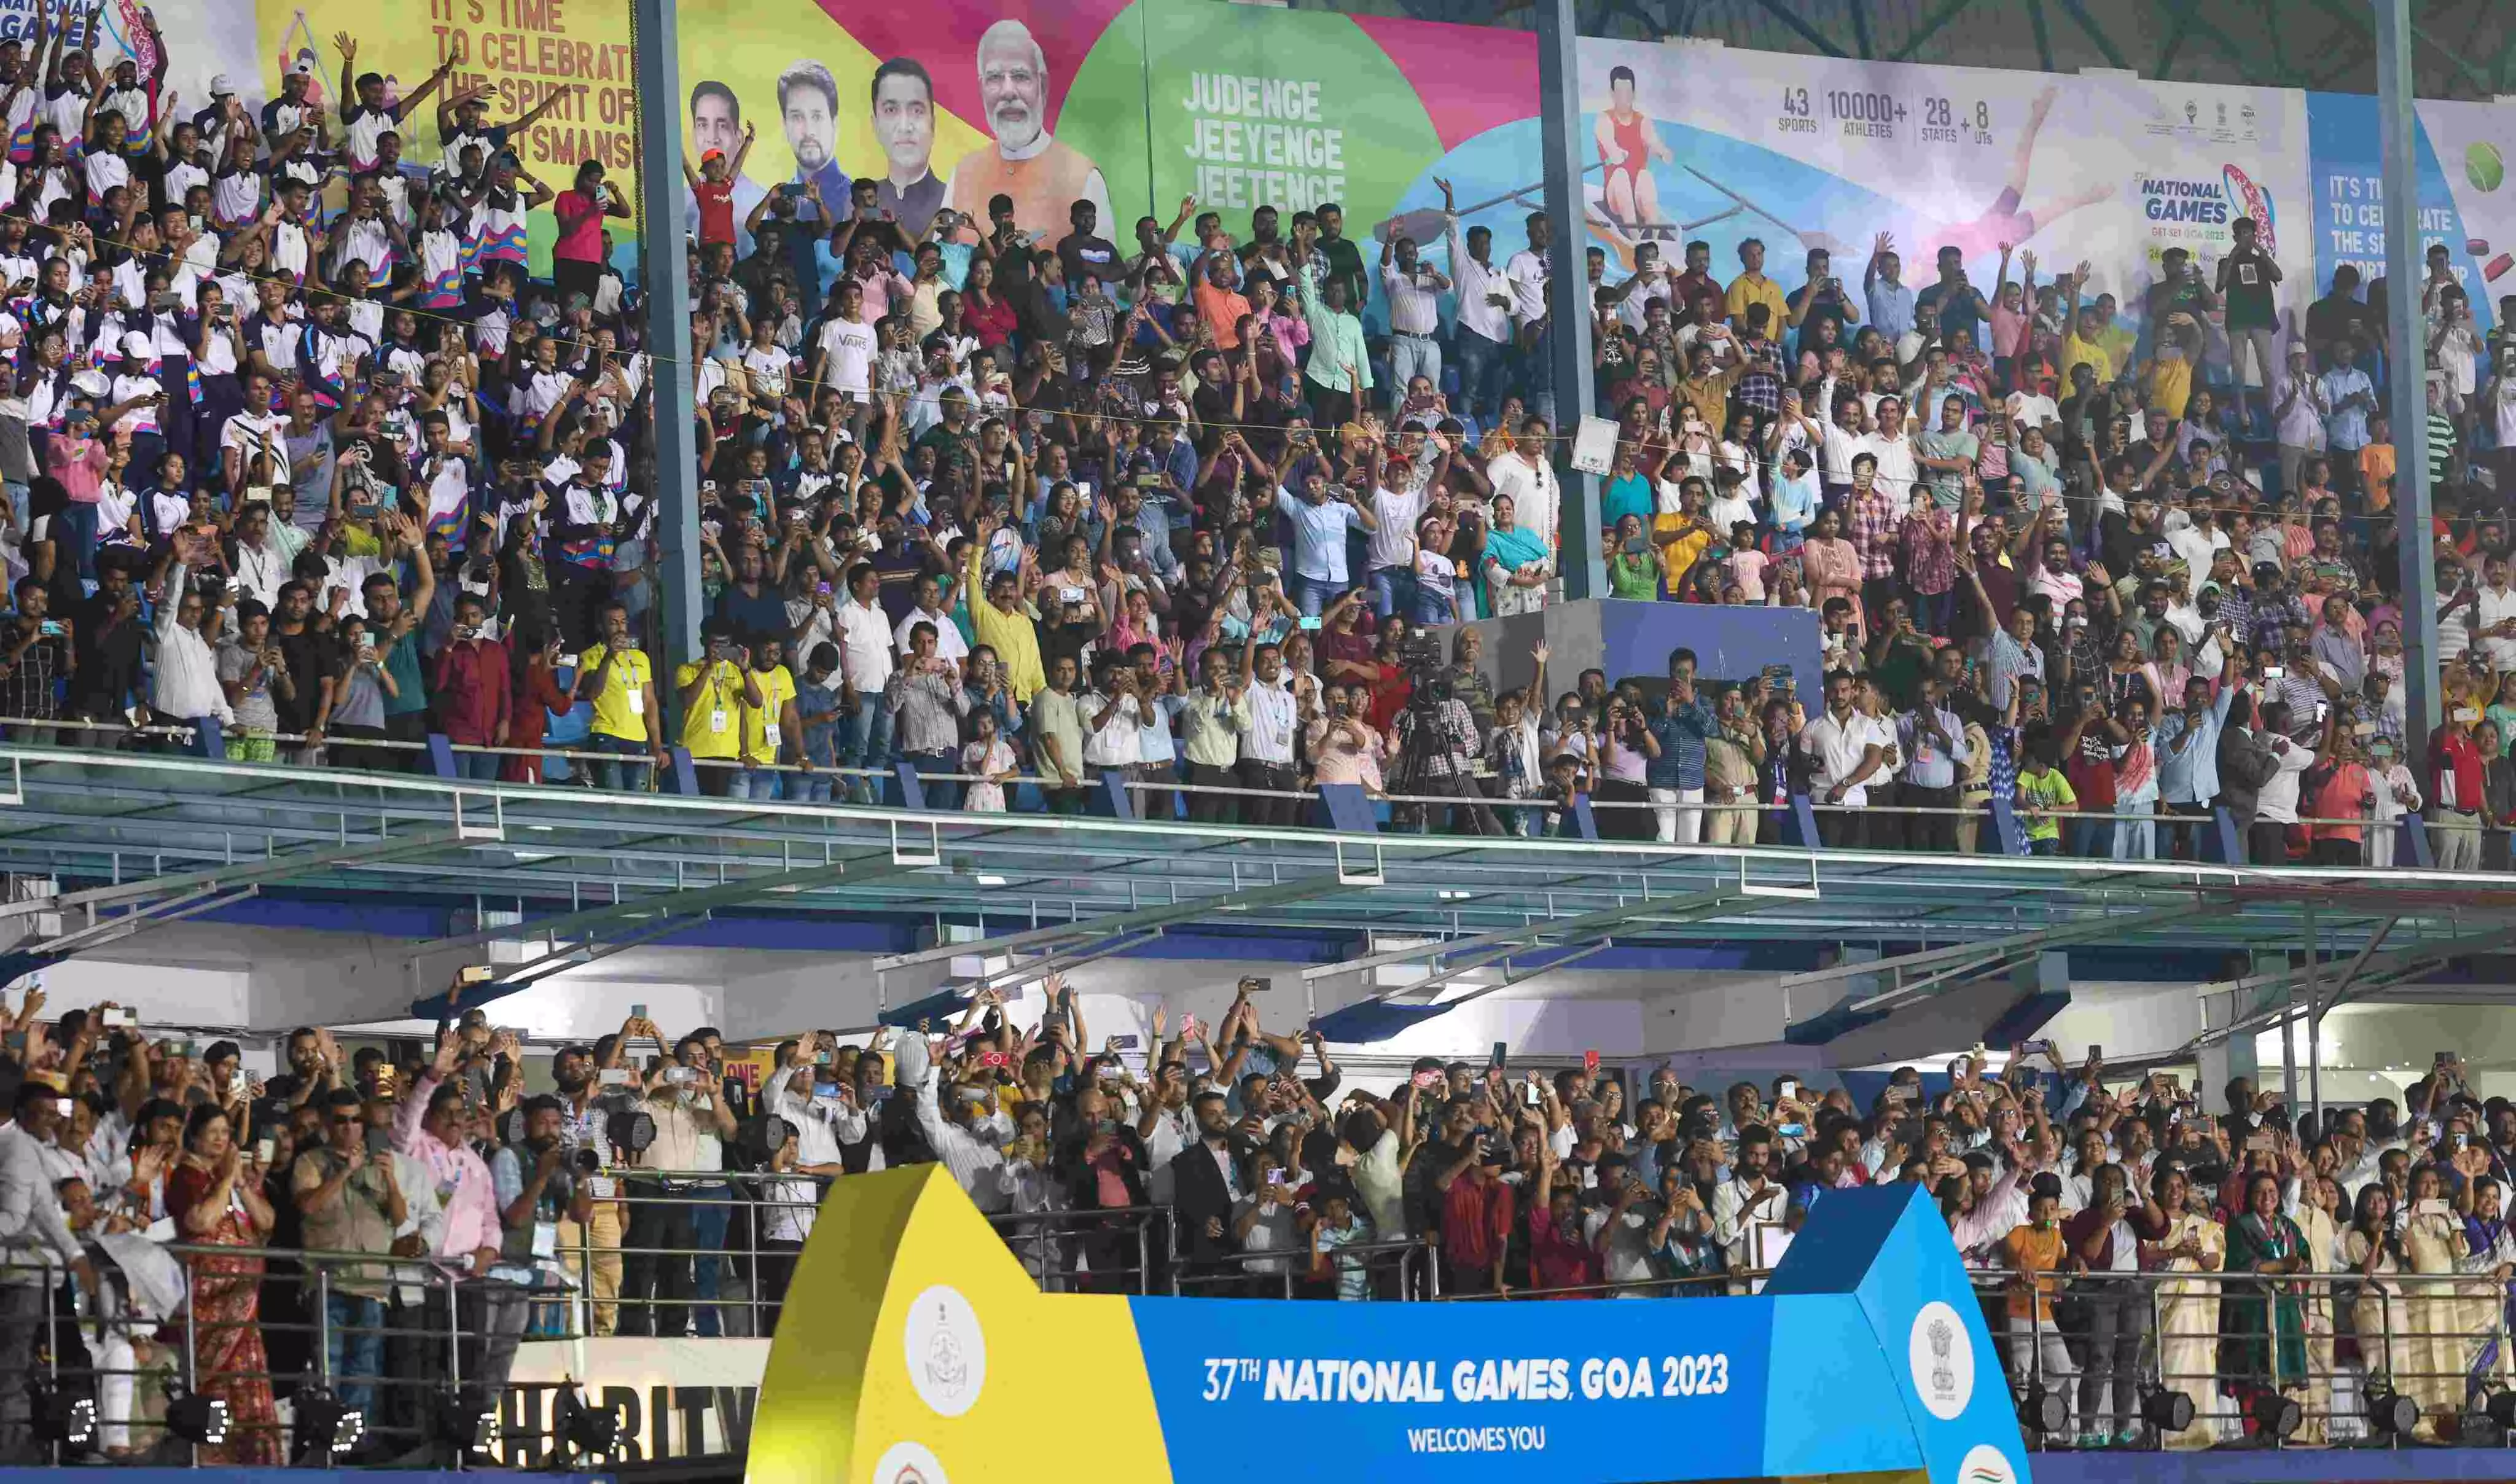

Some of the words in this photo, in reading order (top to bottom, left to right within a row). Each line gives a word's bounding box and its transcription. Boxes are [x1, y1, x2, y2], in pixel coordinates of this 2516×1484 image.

[0, 0, 93, 17] NATONAL
[432, 0, 484, 23] ITS
[501, 0, 565, 33] TIME
[432, 26, 470, 65] TO
[482, 33, 629, 82] CELEBRAT
[499, 77, 590, 122] SPIRIT
[600, 87, 633, 127] OF
[1182, 71, 1322, 123] JUDENGE
[1784, 87, 1809, 117] 43
[1827, 90, 1907, 123] 10000+
[1778, 117, 1817, 134] SPORTS
[1924, 98, 1951, 127] 28
[1976, 101, 1989, 130] 8
[1843, 122, 1893, 138] ATHLETES
[1922, 127, 1957, 144] STATES
[1975, 131, 1993, 145] UTs
[1184, 119, 1345, 171] JEEYENGE
[1187, 165, 1346, 218] JEETENGE
[2141, 179, 2222, 198] NATIONAL
[2329, 175, 2360, 198] IT'S
[2146, 198, 2227, 224] GAMES
[2331, 202, 2353, 225] TO
[2331, 230, 2364, 254] THE
[838, 334, 867, 350] VANS
[1203, 1359, 1260, 1401] 37TH
[1264, 1359, 1444, 1403] NATIONAL
[1580, 1357, 1654, 1400] GOA
[1663, 1353, 1729, 1396] 2023
[1408, 1427, 1506, 1453] WELCOMES
[1507, 1426, 1545, 1450] YOU
